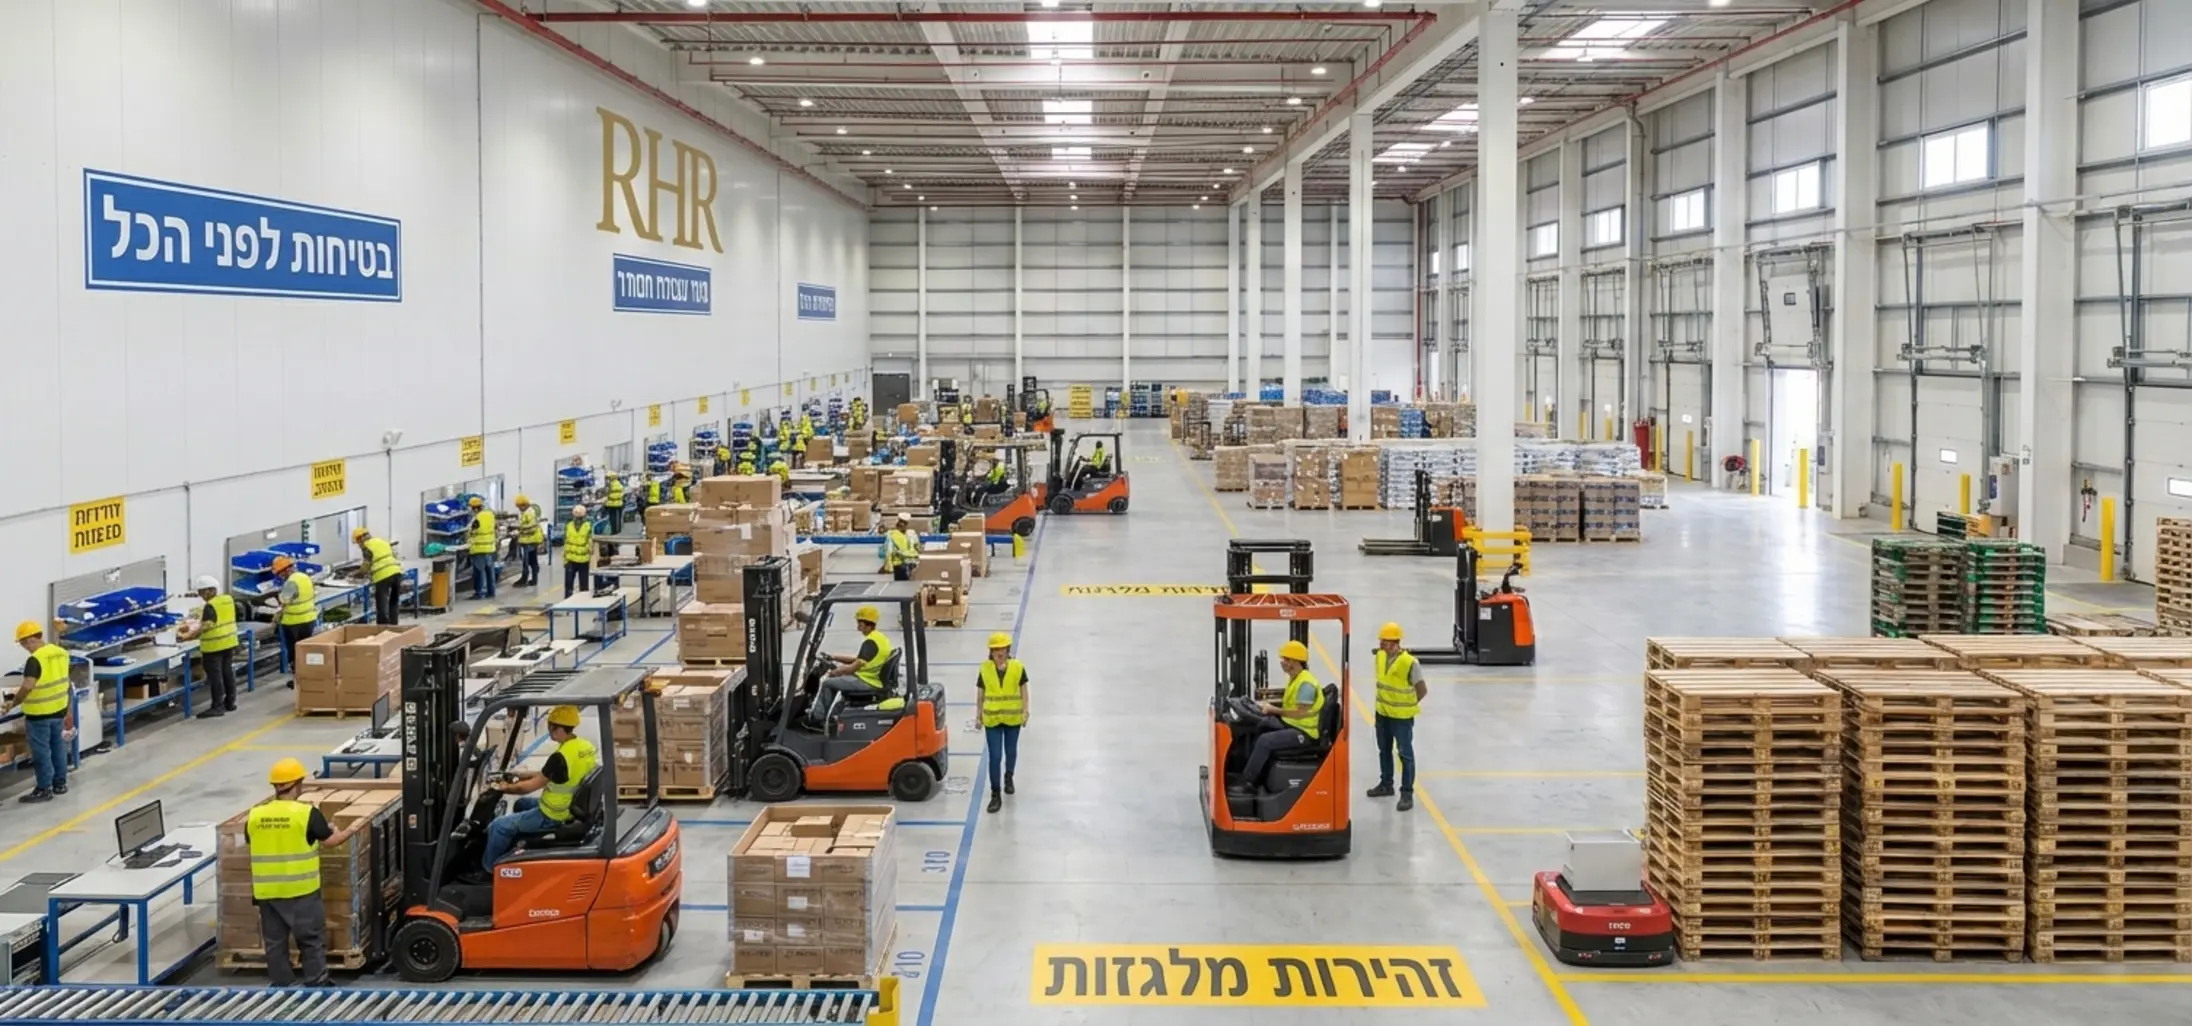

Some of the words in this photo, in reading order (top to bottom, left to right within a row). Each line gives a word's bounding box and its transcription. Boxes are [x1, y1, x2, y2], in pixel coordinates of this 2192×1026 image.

[596, 106, 723, 254] RHR
[103, 194, 190, 264] הכל
[204, 216, 281, 271] לפני
[290, 231, 393, 279] בטיחות
[1045, 948, 1249, 997] מלגזות
[1268, 957, 1463, 998] זהירות
